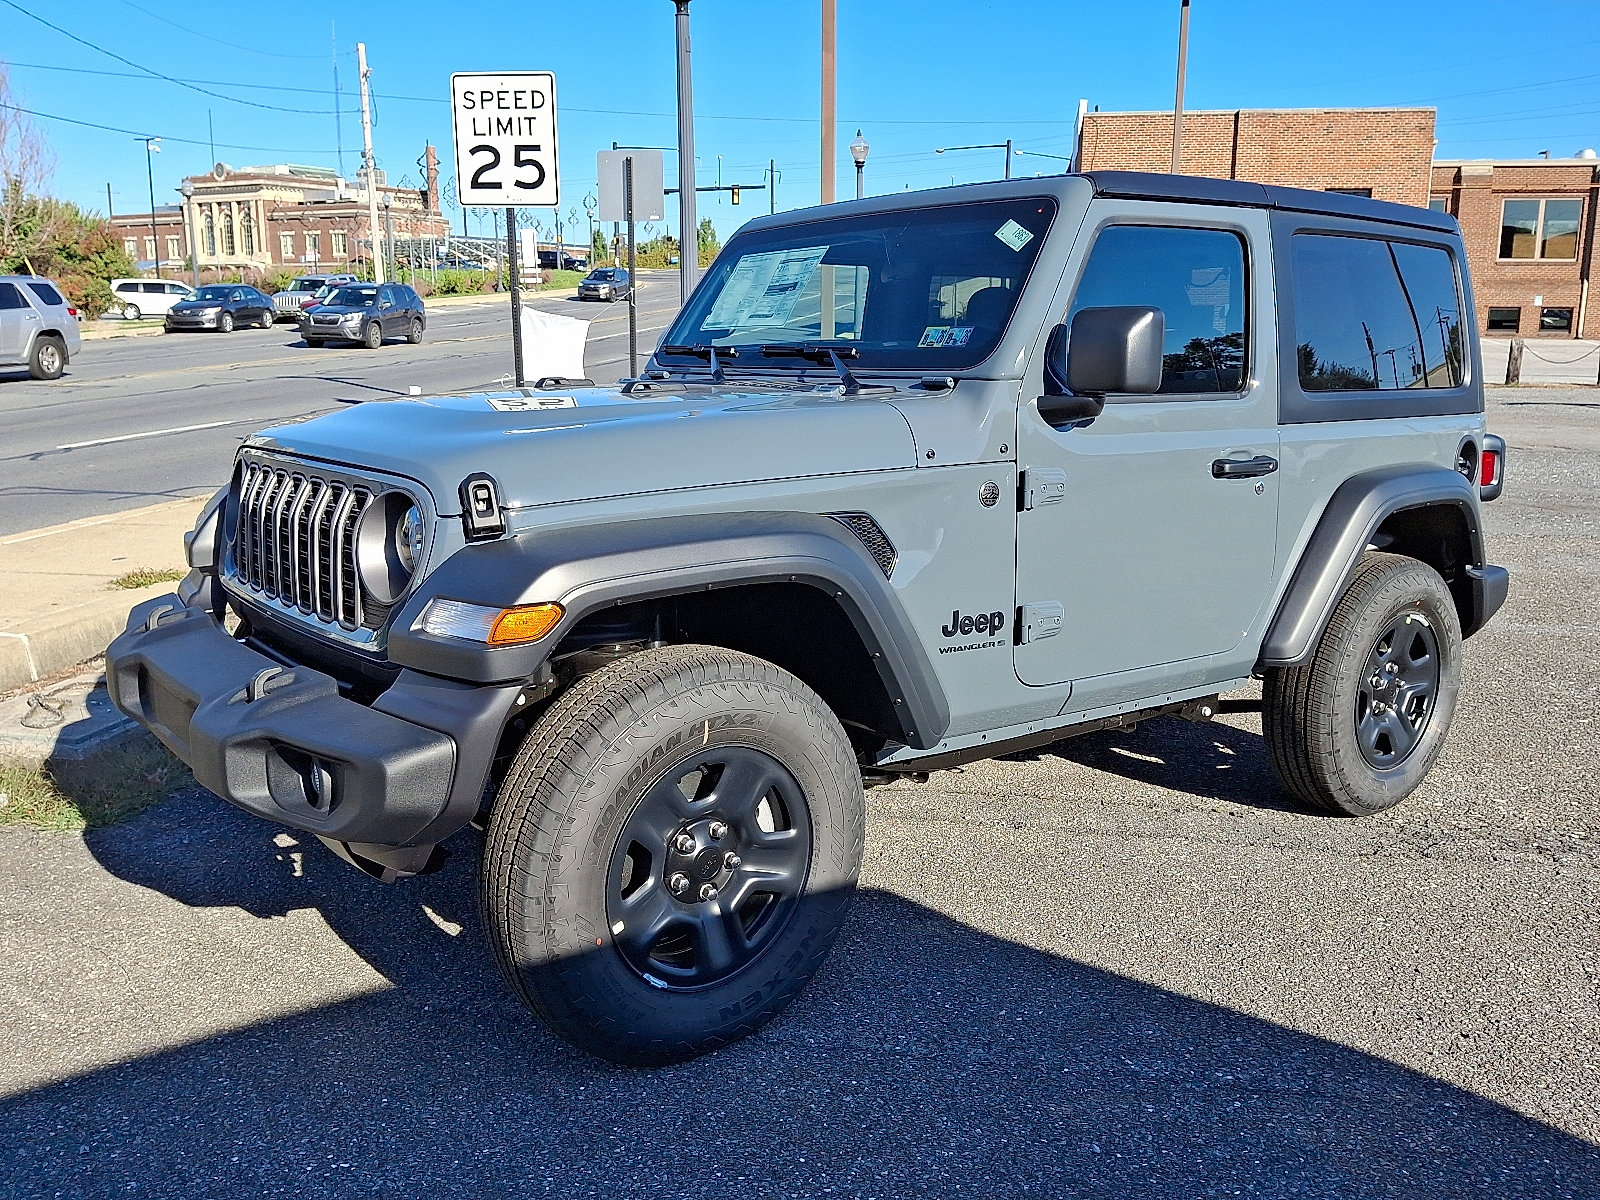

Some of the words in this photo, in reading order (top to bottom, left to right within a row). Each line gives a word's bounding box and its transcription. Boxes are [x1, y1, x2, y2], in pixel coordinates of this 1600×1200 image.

[462, 90, 545, 110] SPEED
[472, 116, 537, 136] LIMIT
[468, 144, 546, 190] 25
[941, 609, 1005, 638] Jeep
[938, 641, 996, 655] WRANGLER
[592, 731, 683, 849] ROADIAN
